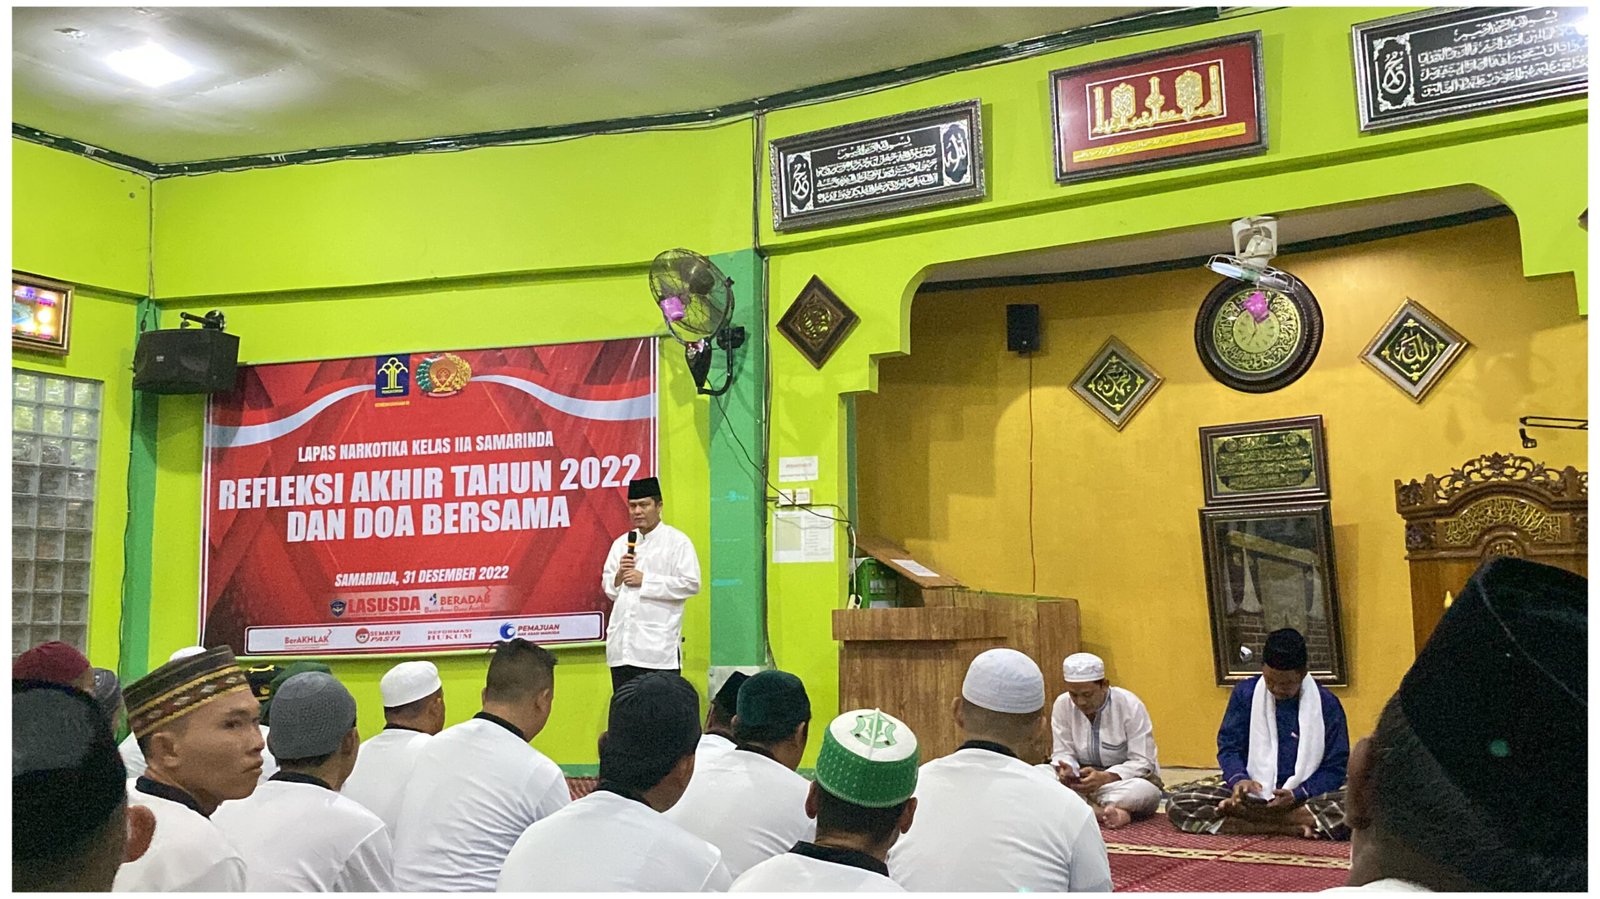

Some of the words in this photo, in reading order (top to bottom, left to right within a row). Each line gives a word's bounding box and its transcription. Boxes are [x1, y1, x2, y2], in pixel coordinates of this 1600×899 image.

[298, 445, 336, 462] LAPAS
[340, 440, 408, 460] NARKOTIKA
[412, 437, 450, 456] KELAS
[455, 436, 472, 453] IIA
[476, 430, 554, 451] SAMARINDA
[218, 472, 344, 510] REFLEKSI
[350, 466, 444, 503] AKHIR
[451, 460, 552, 497] TAHUN
[560, 453, 641, 491] 2022
[287, 508, 345, 542] DAN
[353, 505, 415, 539] DOA
[422, 495, 571, 536] BERSAMA
[335, 571, 399, 587] SAMARINDA,
[402, 570, 415, 584] 31
[418, 567, 476, 583] DESEMBER
[478, 566, 510, 580] 2022
[349, 595, 421, 614] LASUSDA
[427, 633, 472, 641] HUKUM
[517, 624, 560, 632] PEMAJUAN
[284, 634, 330, 645] BerAKHLAK
